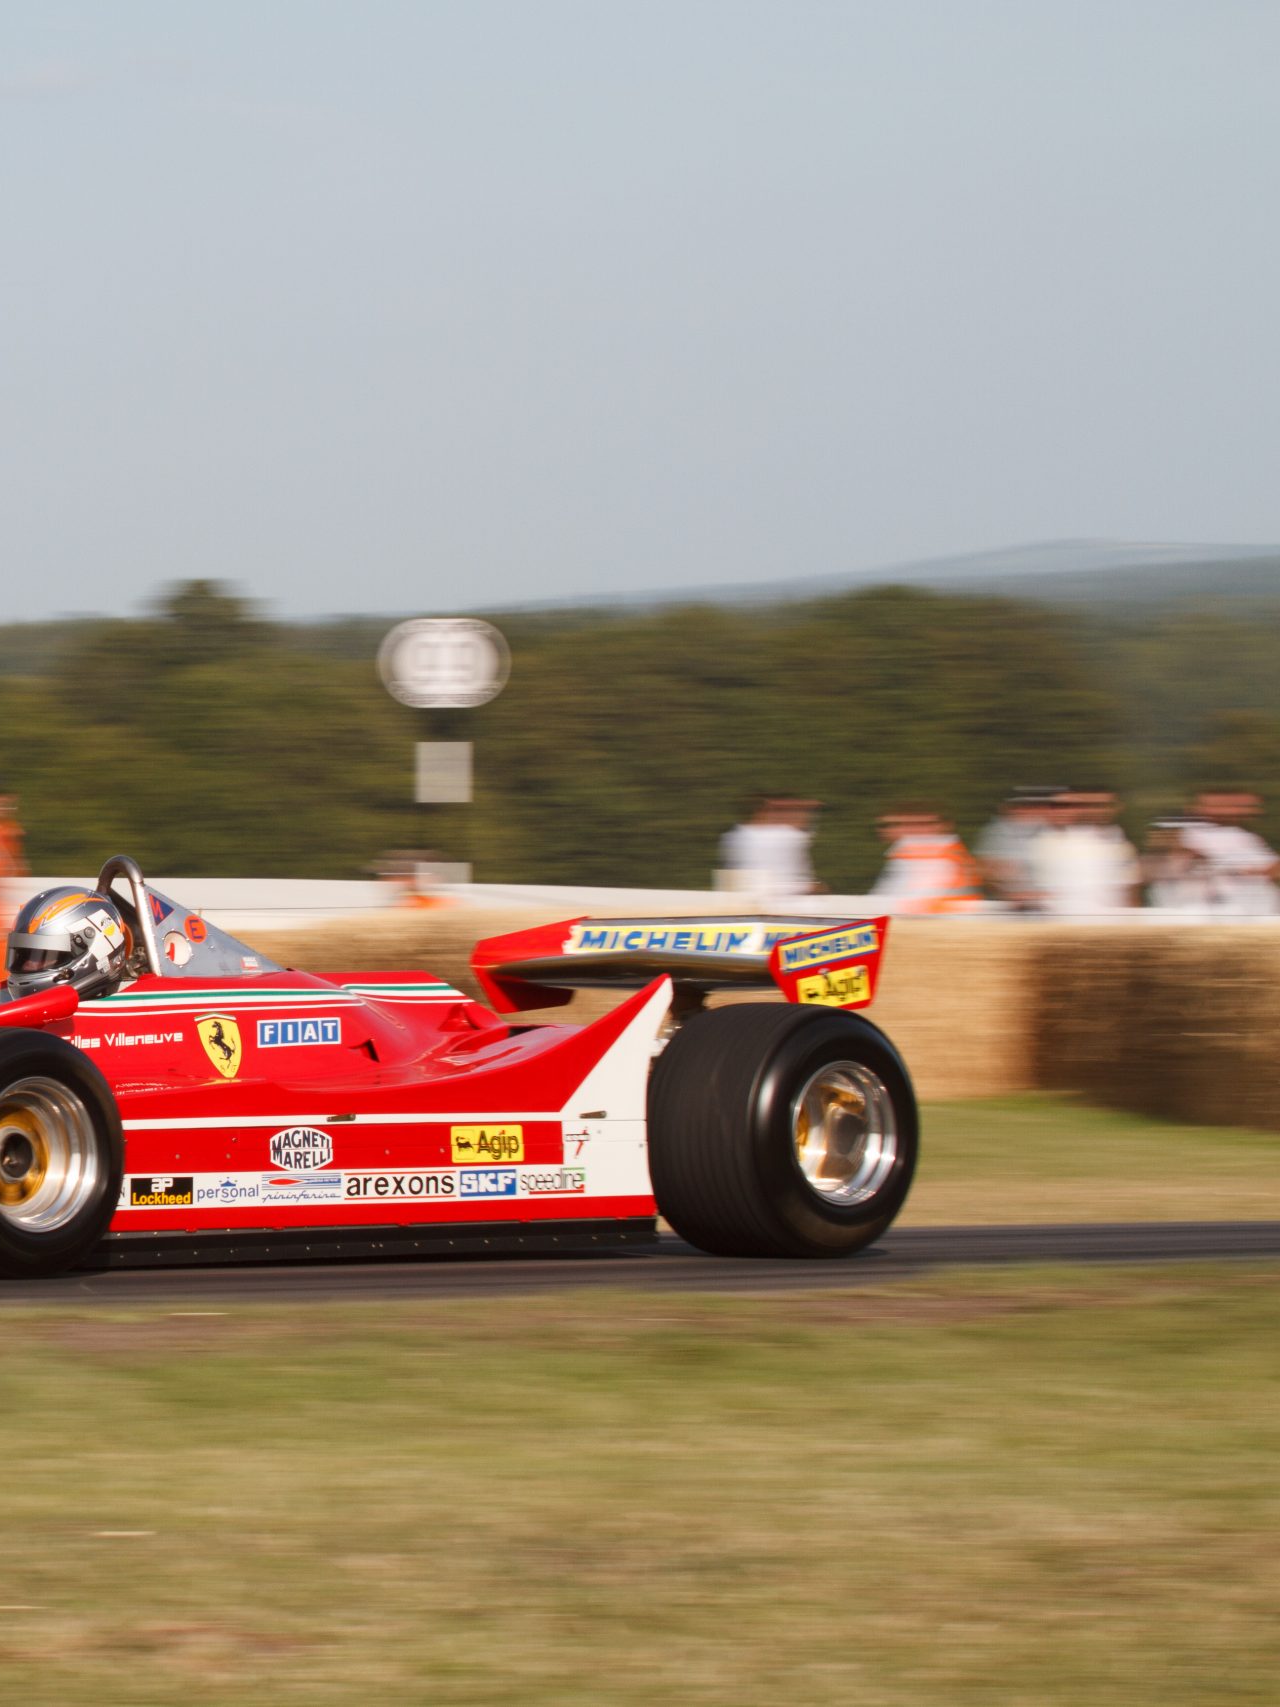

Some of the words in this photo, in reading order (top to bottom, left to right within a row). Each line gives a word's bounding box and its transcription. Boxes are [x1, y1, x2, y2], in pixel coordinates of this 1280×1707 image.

[104, 1032, 183, 1047] Villeneuve
[262, 1022, 338, 1046] FIAT
[271, 1129, 330, 1150] MAGNETI
[477, 1130, 520, 1160] Agip
[272, 1148, 331, 1169] MARELLI
[197, 1184, 259, 1202] personal
[346, 1174, 455, 1196] arexons
[461, 1172, 515, 1194] SKF
[133, 1192, 191, 1205] Lockheed
[262, 1190, 341, 1204] pininfarina
